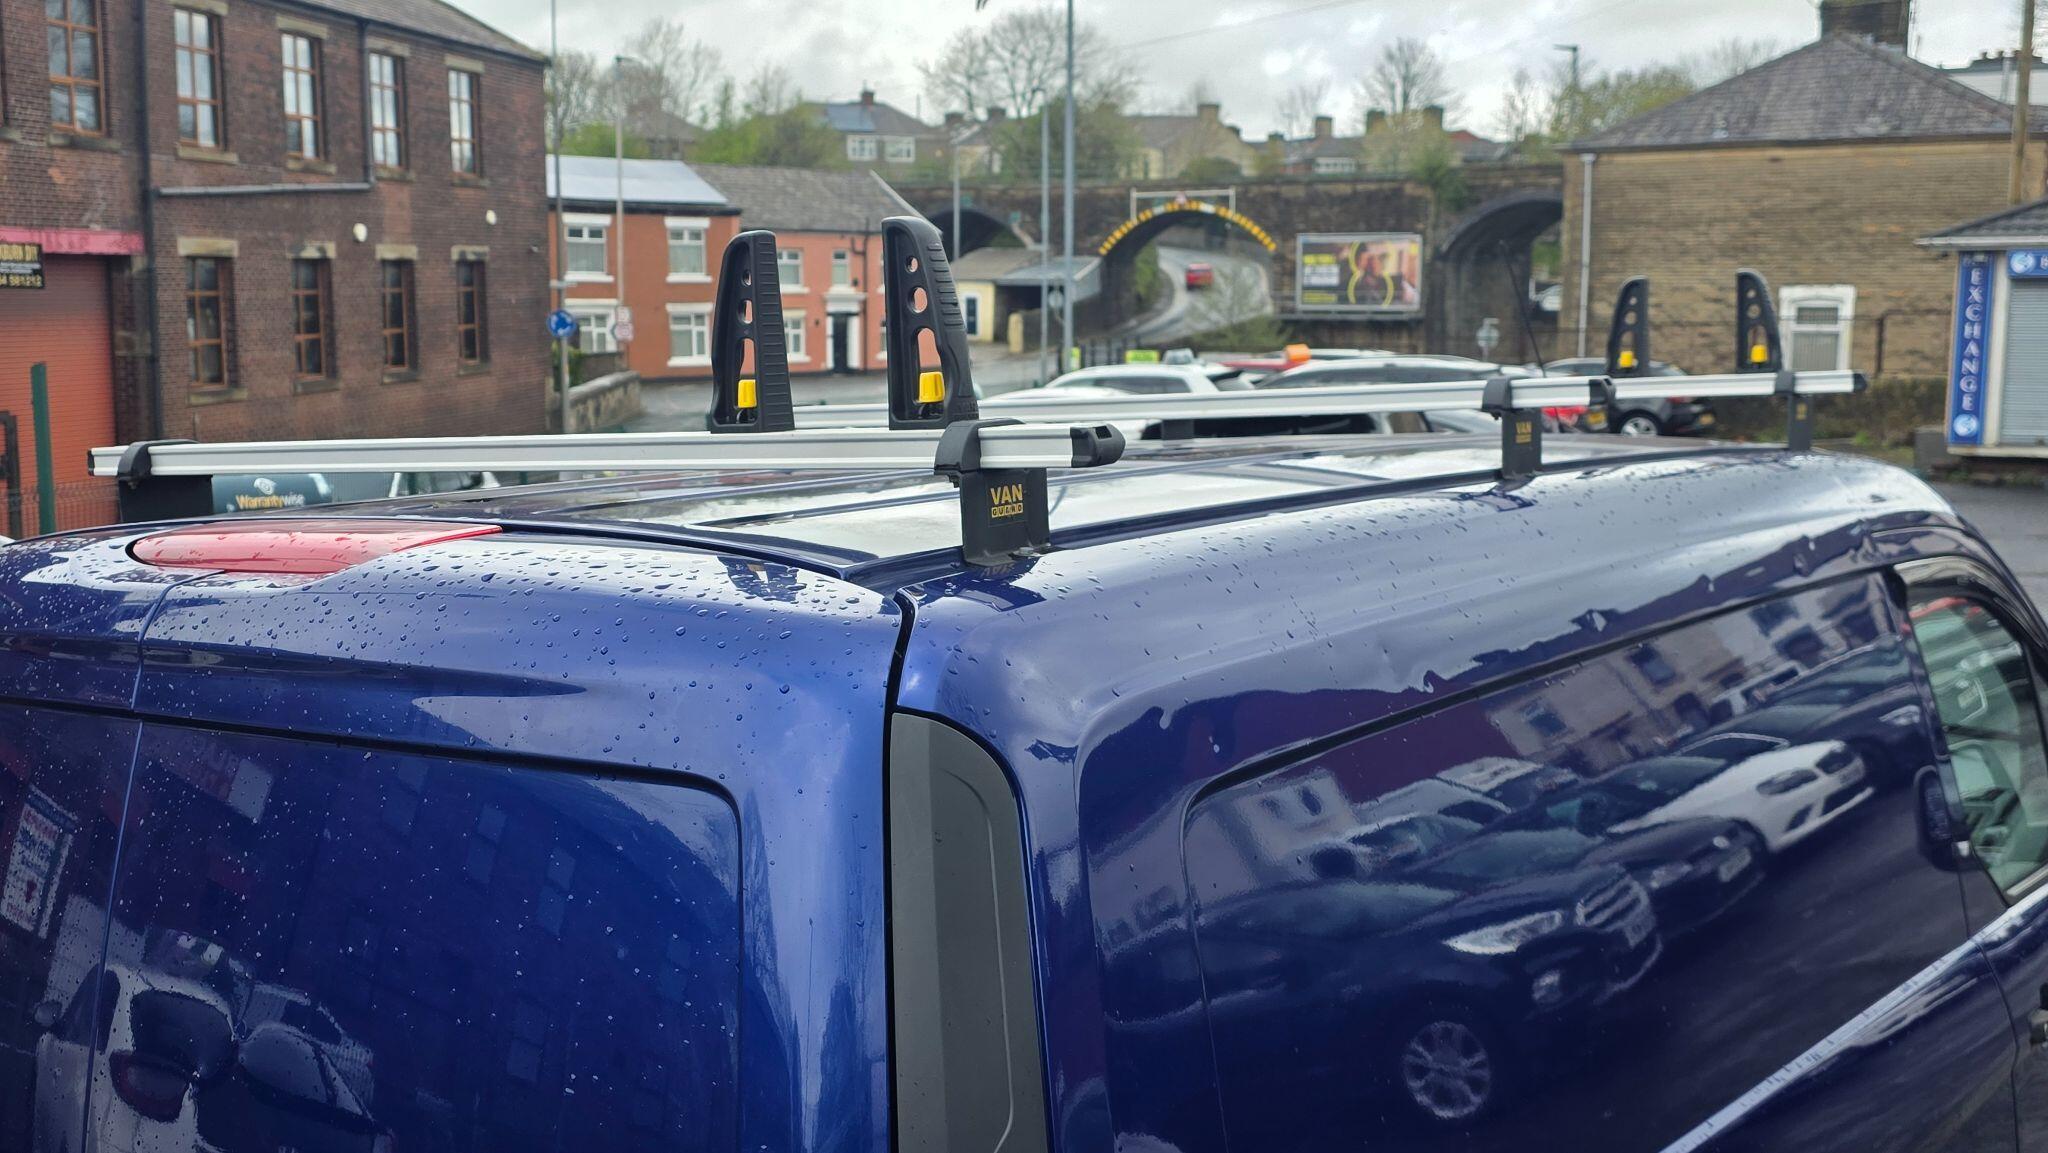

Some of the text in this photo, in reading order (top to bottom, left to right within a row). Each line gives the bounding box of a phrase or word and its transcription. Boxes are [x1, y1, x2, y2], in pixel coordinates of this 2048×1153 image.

[1959, 267, 1984, 411] EXCHANGE
[235, 491, 305, 509] Warrantywise
[990, 484, 1024, 505] VAN
